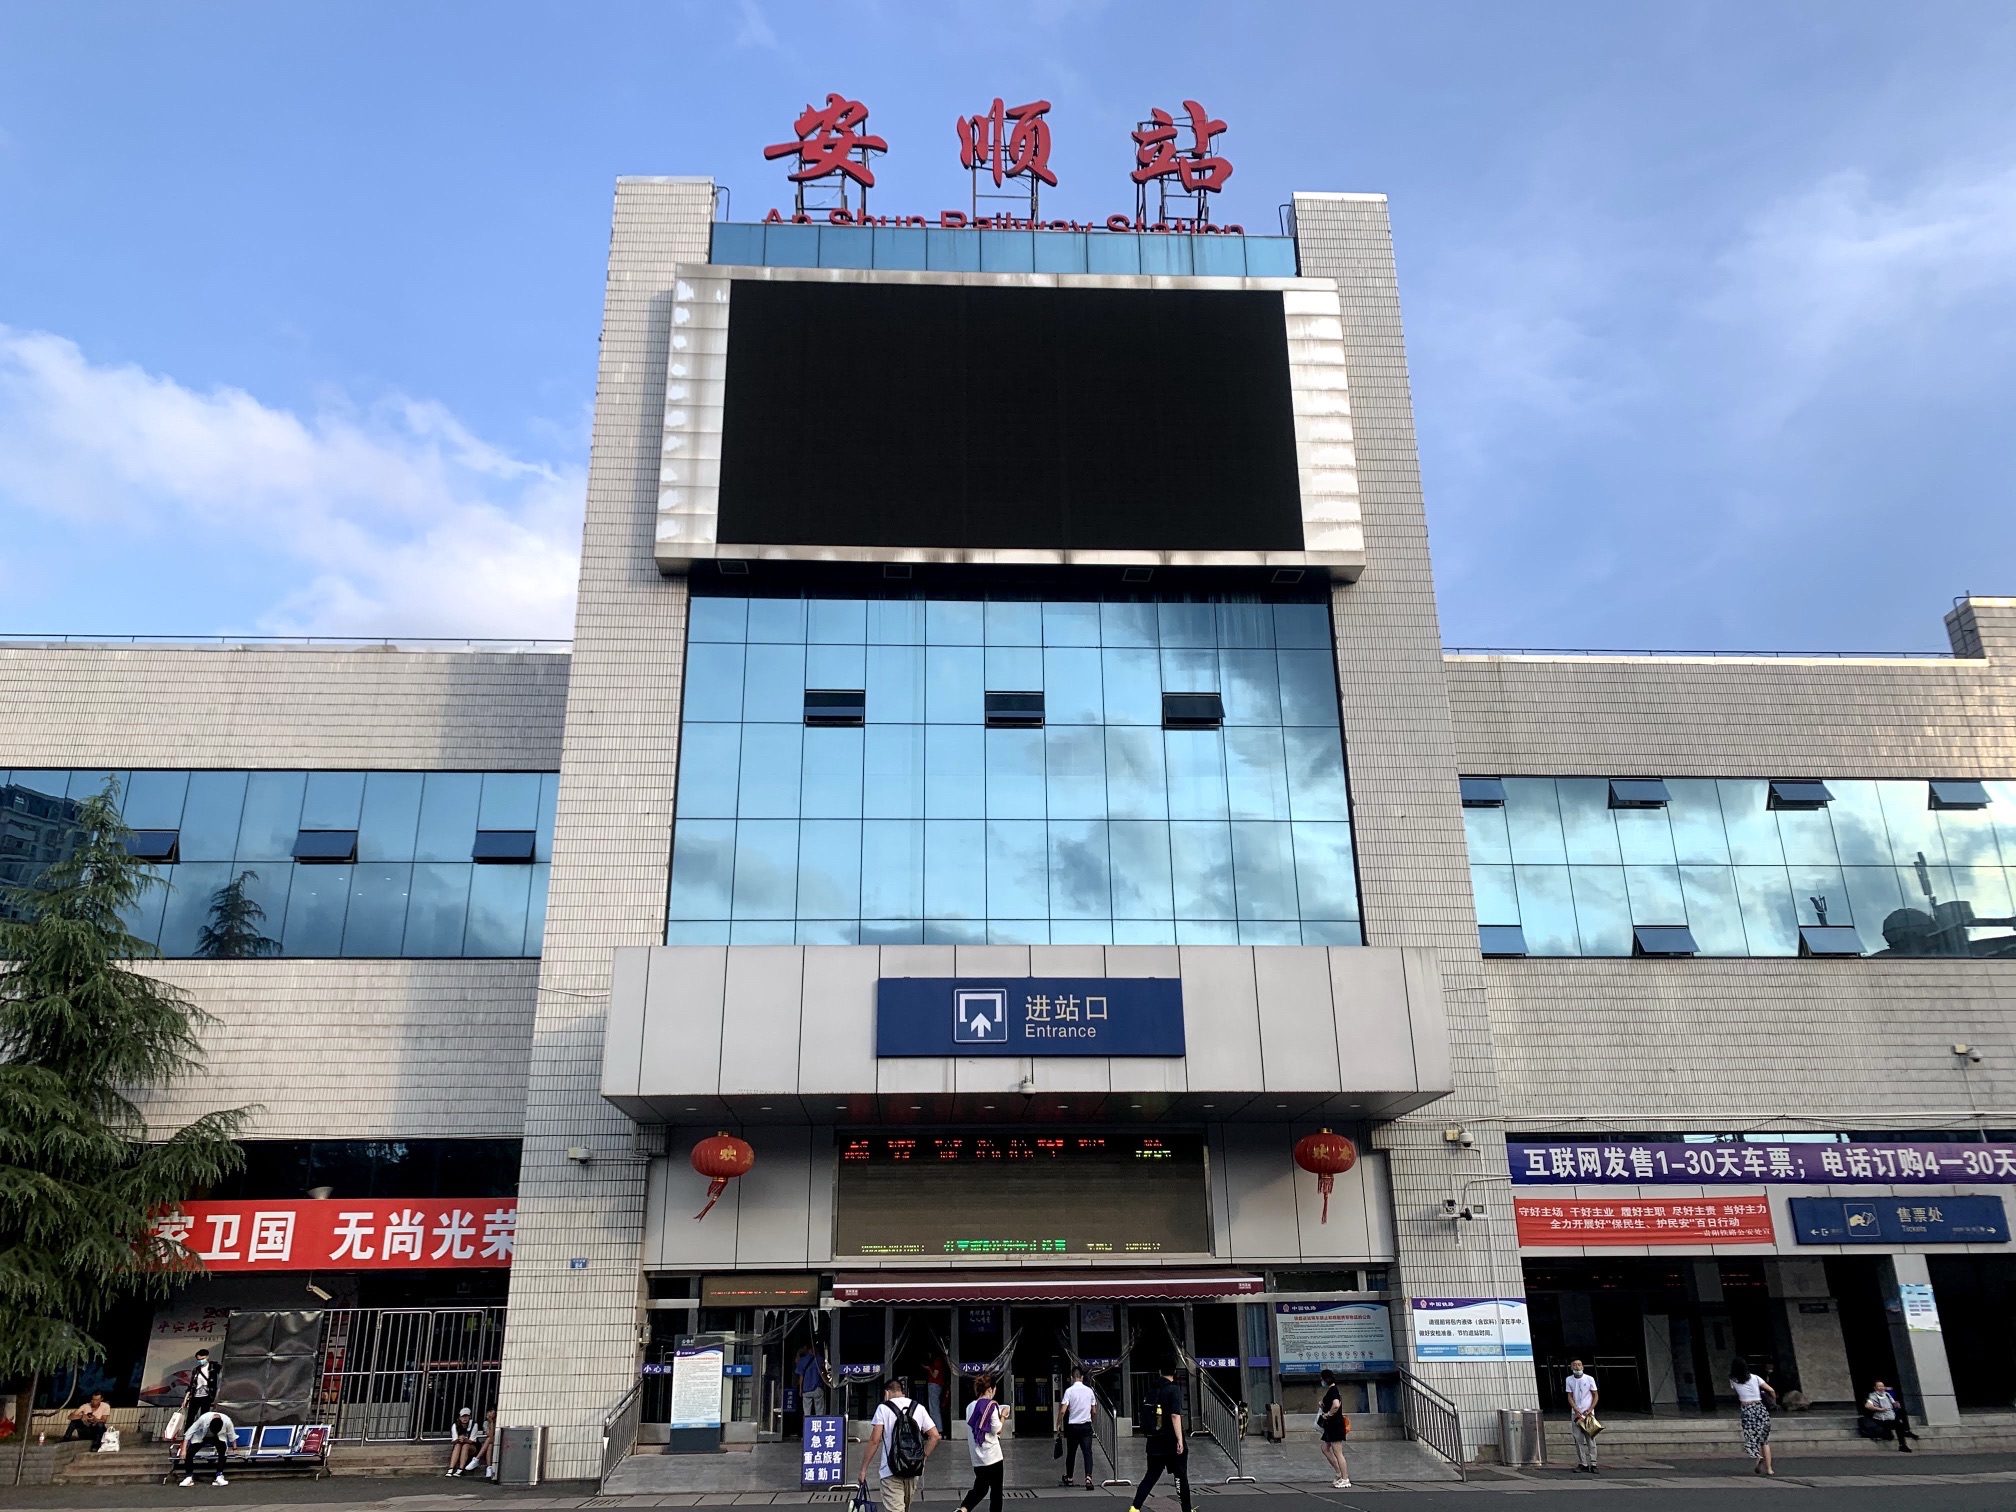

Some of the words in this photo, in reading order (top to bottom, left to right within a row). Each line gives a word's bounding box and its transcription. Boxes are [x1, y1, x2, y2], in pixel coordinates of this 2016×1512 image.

[763, 92, 1234, 194] 安顺站
[1025, 994, 1107, 1021] 进站口
[1025, 1024, 1096, 1038] Entrance
[1518, 1206, 1563, 1217] 守好主场
[1570, 1206, 1615, 1217] 干好主业
[1621, 1206, 1666, 1217] 履好主职
[1672, 1205, 1716, 1217] 尽好主责
[1723, 1204, 1767, 1215] 当好主力
[1896, 1206, 1944, 1222] 售票处
[328, 1208, 517, 1261] 无尚光荣
[811, 1420, 836, 1433] 职工
[811, 1435, 836, 1448] 急客
[803, 1451, 842, 1465] 重点旅客
[804, 1468, 841, 1480] 通勤口
